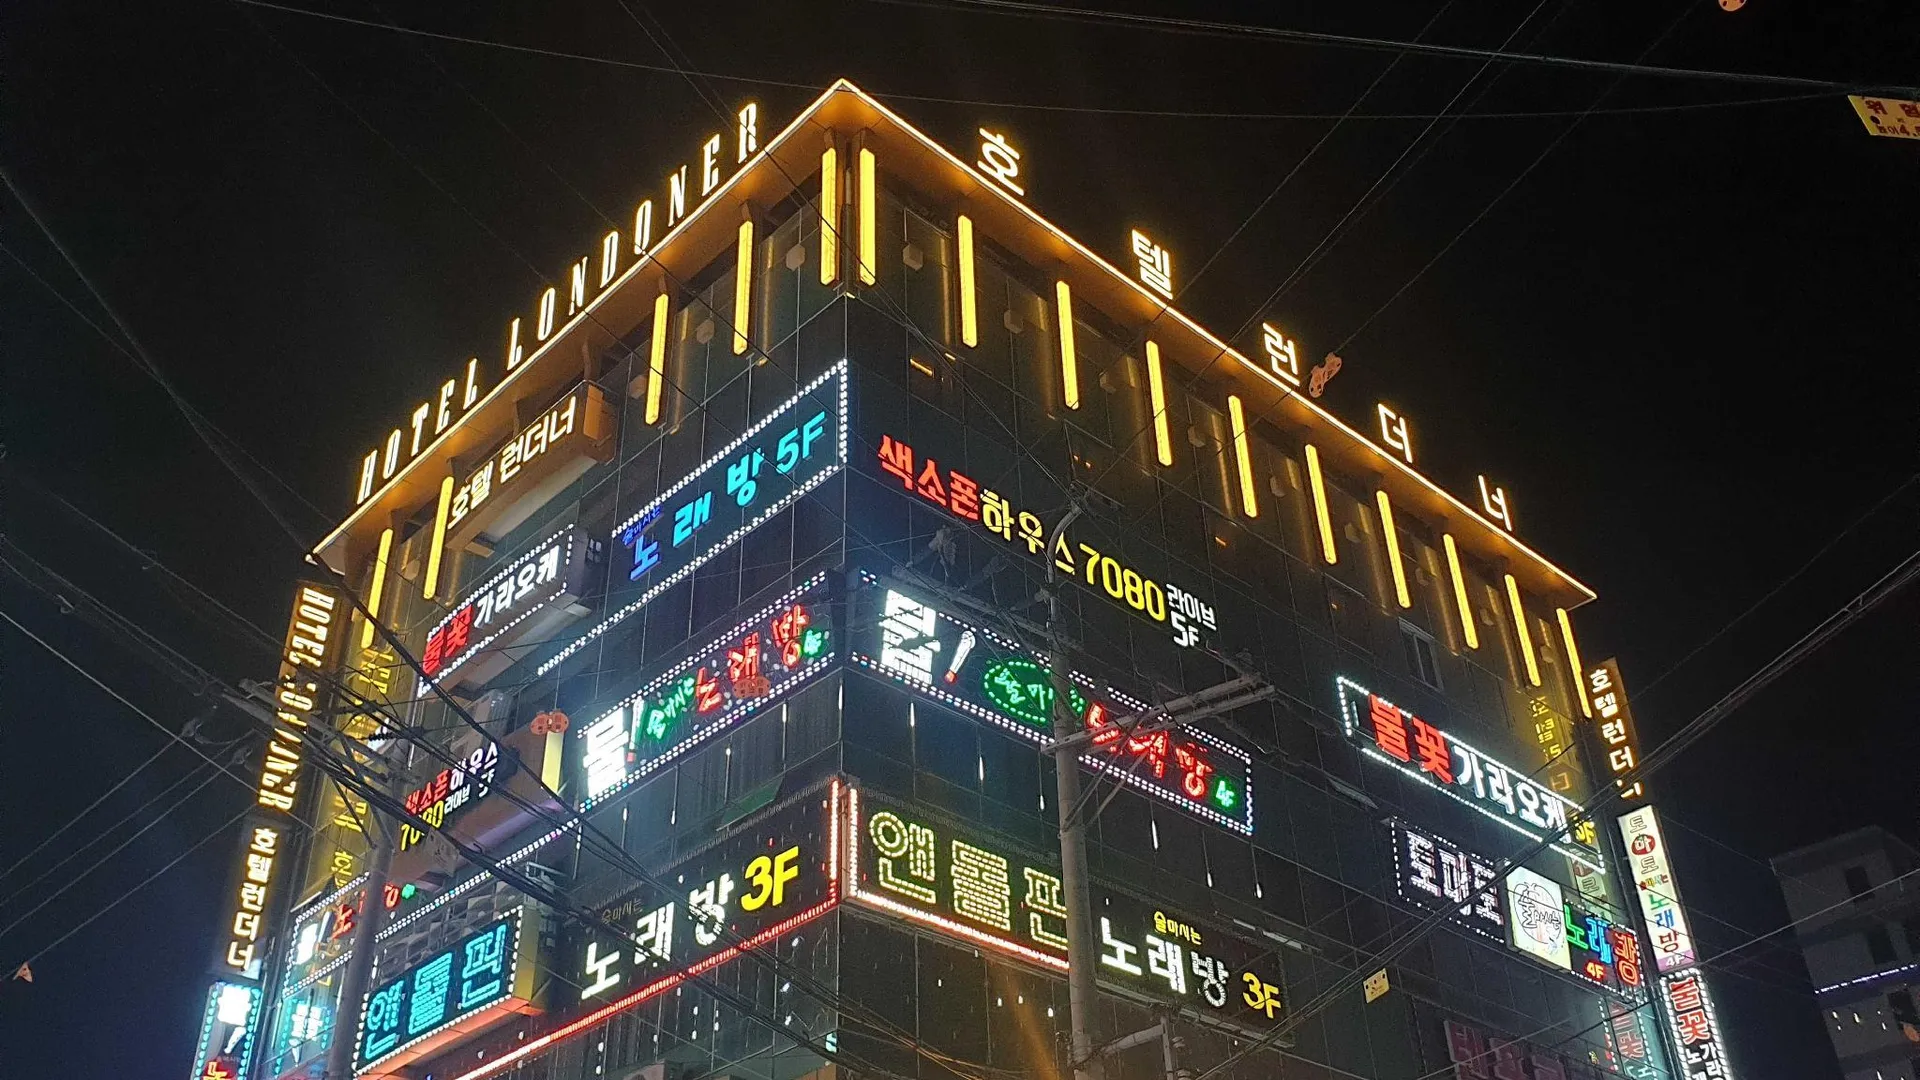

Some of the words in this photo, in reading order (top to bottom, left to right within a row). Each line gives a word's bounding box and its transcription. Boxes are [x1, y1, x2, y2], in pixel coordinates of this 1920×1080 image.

[357, 358, 479, 505] HOTEL
[505, 102, 759, 370] LONDONER
[447, 460, 494, 529] 호텔
[500, 397, 576, 484] 런더너
[776, 411, 826, 475] 5F
[1166, 583, 1217, 631] 라이브
[1170, 611, 1199, 647] 5F
[741, 845, 799, 911] 3F
[1154, 911, 1202, 946] 술마시는
[1100, 916, 1229, 1008] 노래방
[1242, 971, 1282, 1019] 3F
[1586, 962, 1604, 978] 4F
[1669, 976, 1711, 1045] 불꽃
